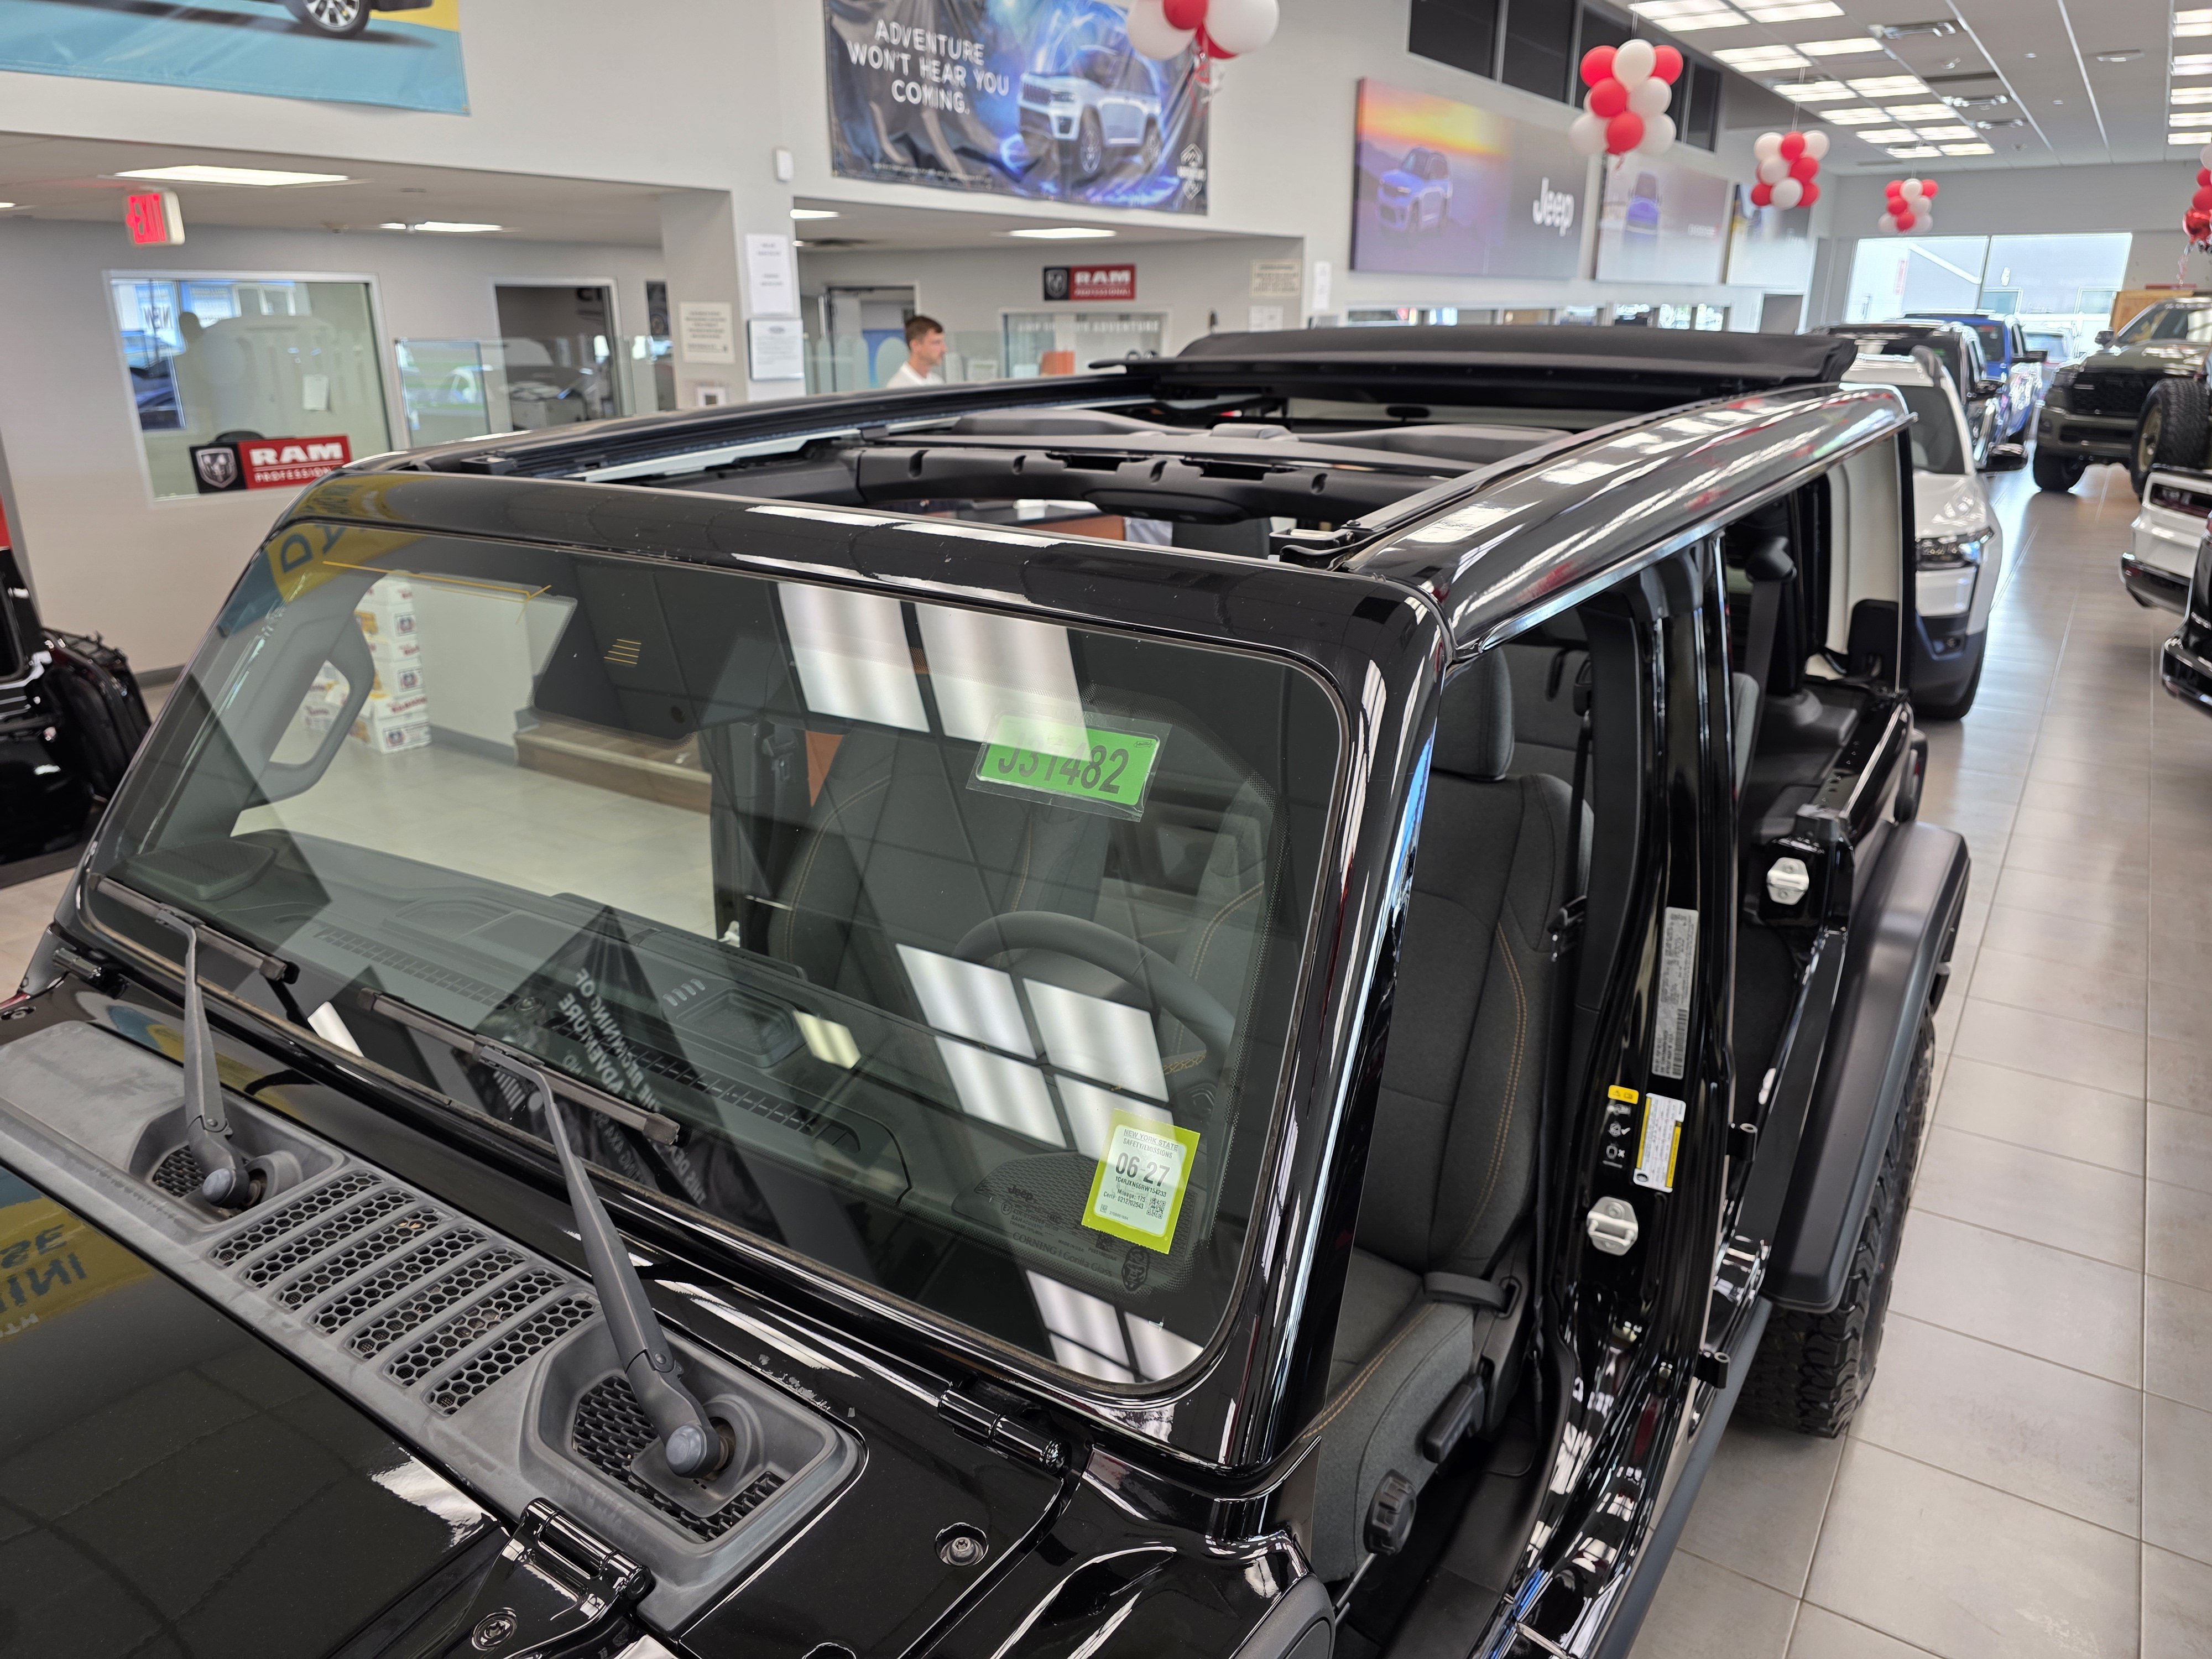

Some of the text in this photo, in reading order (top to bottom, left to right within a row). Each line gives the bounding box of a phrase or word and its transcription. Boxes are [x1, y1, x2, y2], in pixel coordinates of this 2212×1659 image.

[874, 19, 984, 66] ADVENTURE
[847, 40, 1009, 96] WON'T HEAR YOU
[891, 79, 970, 115] COMING.
[1532, 176, 1574, 237] Jeep
[1074, 270, 1131, 284] RAM
[250, 442, 344, 466] RAM
[254, 466, 335, 483] PROFESSION
[1124, 1129, 1179, 1151] NEW YORK STATE
[1008, 1185, 1034, 1202] Jeep
[1117, 1189, 1136, 1199] Mileage:
[1013, 1232, 1112, 1277] CORNING Gorilla Glass
